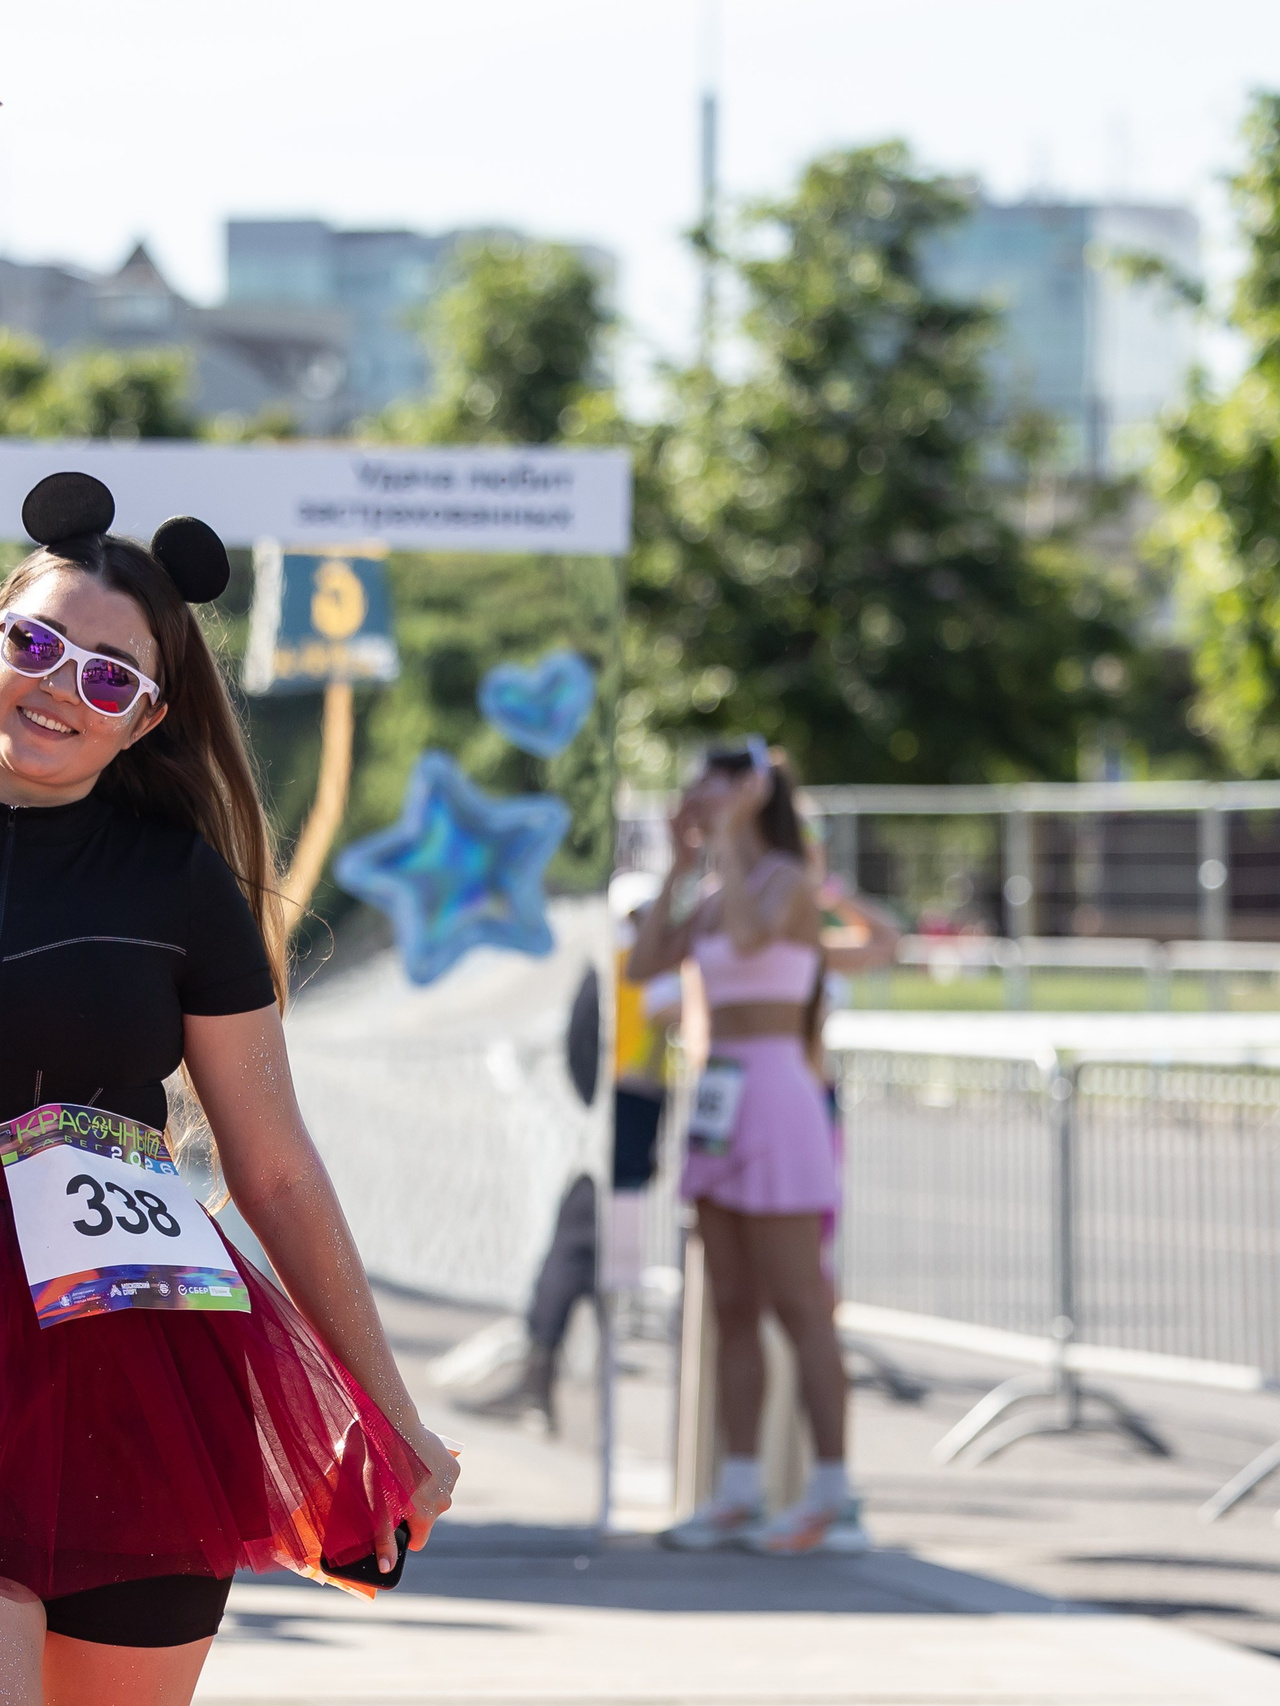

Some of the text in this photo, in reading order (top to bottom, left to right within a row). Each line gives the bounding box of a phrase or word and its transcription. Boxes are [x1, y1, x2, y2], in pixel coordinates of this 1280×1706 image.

[16, 1109, 161, 1160] КРАСОЧНЫЙ
[110, 1145, 175, 1176] 2026
[66, 1174, 181, 1238] 338
[188, 1286, 209, 1295] СБЕР
